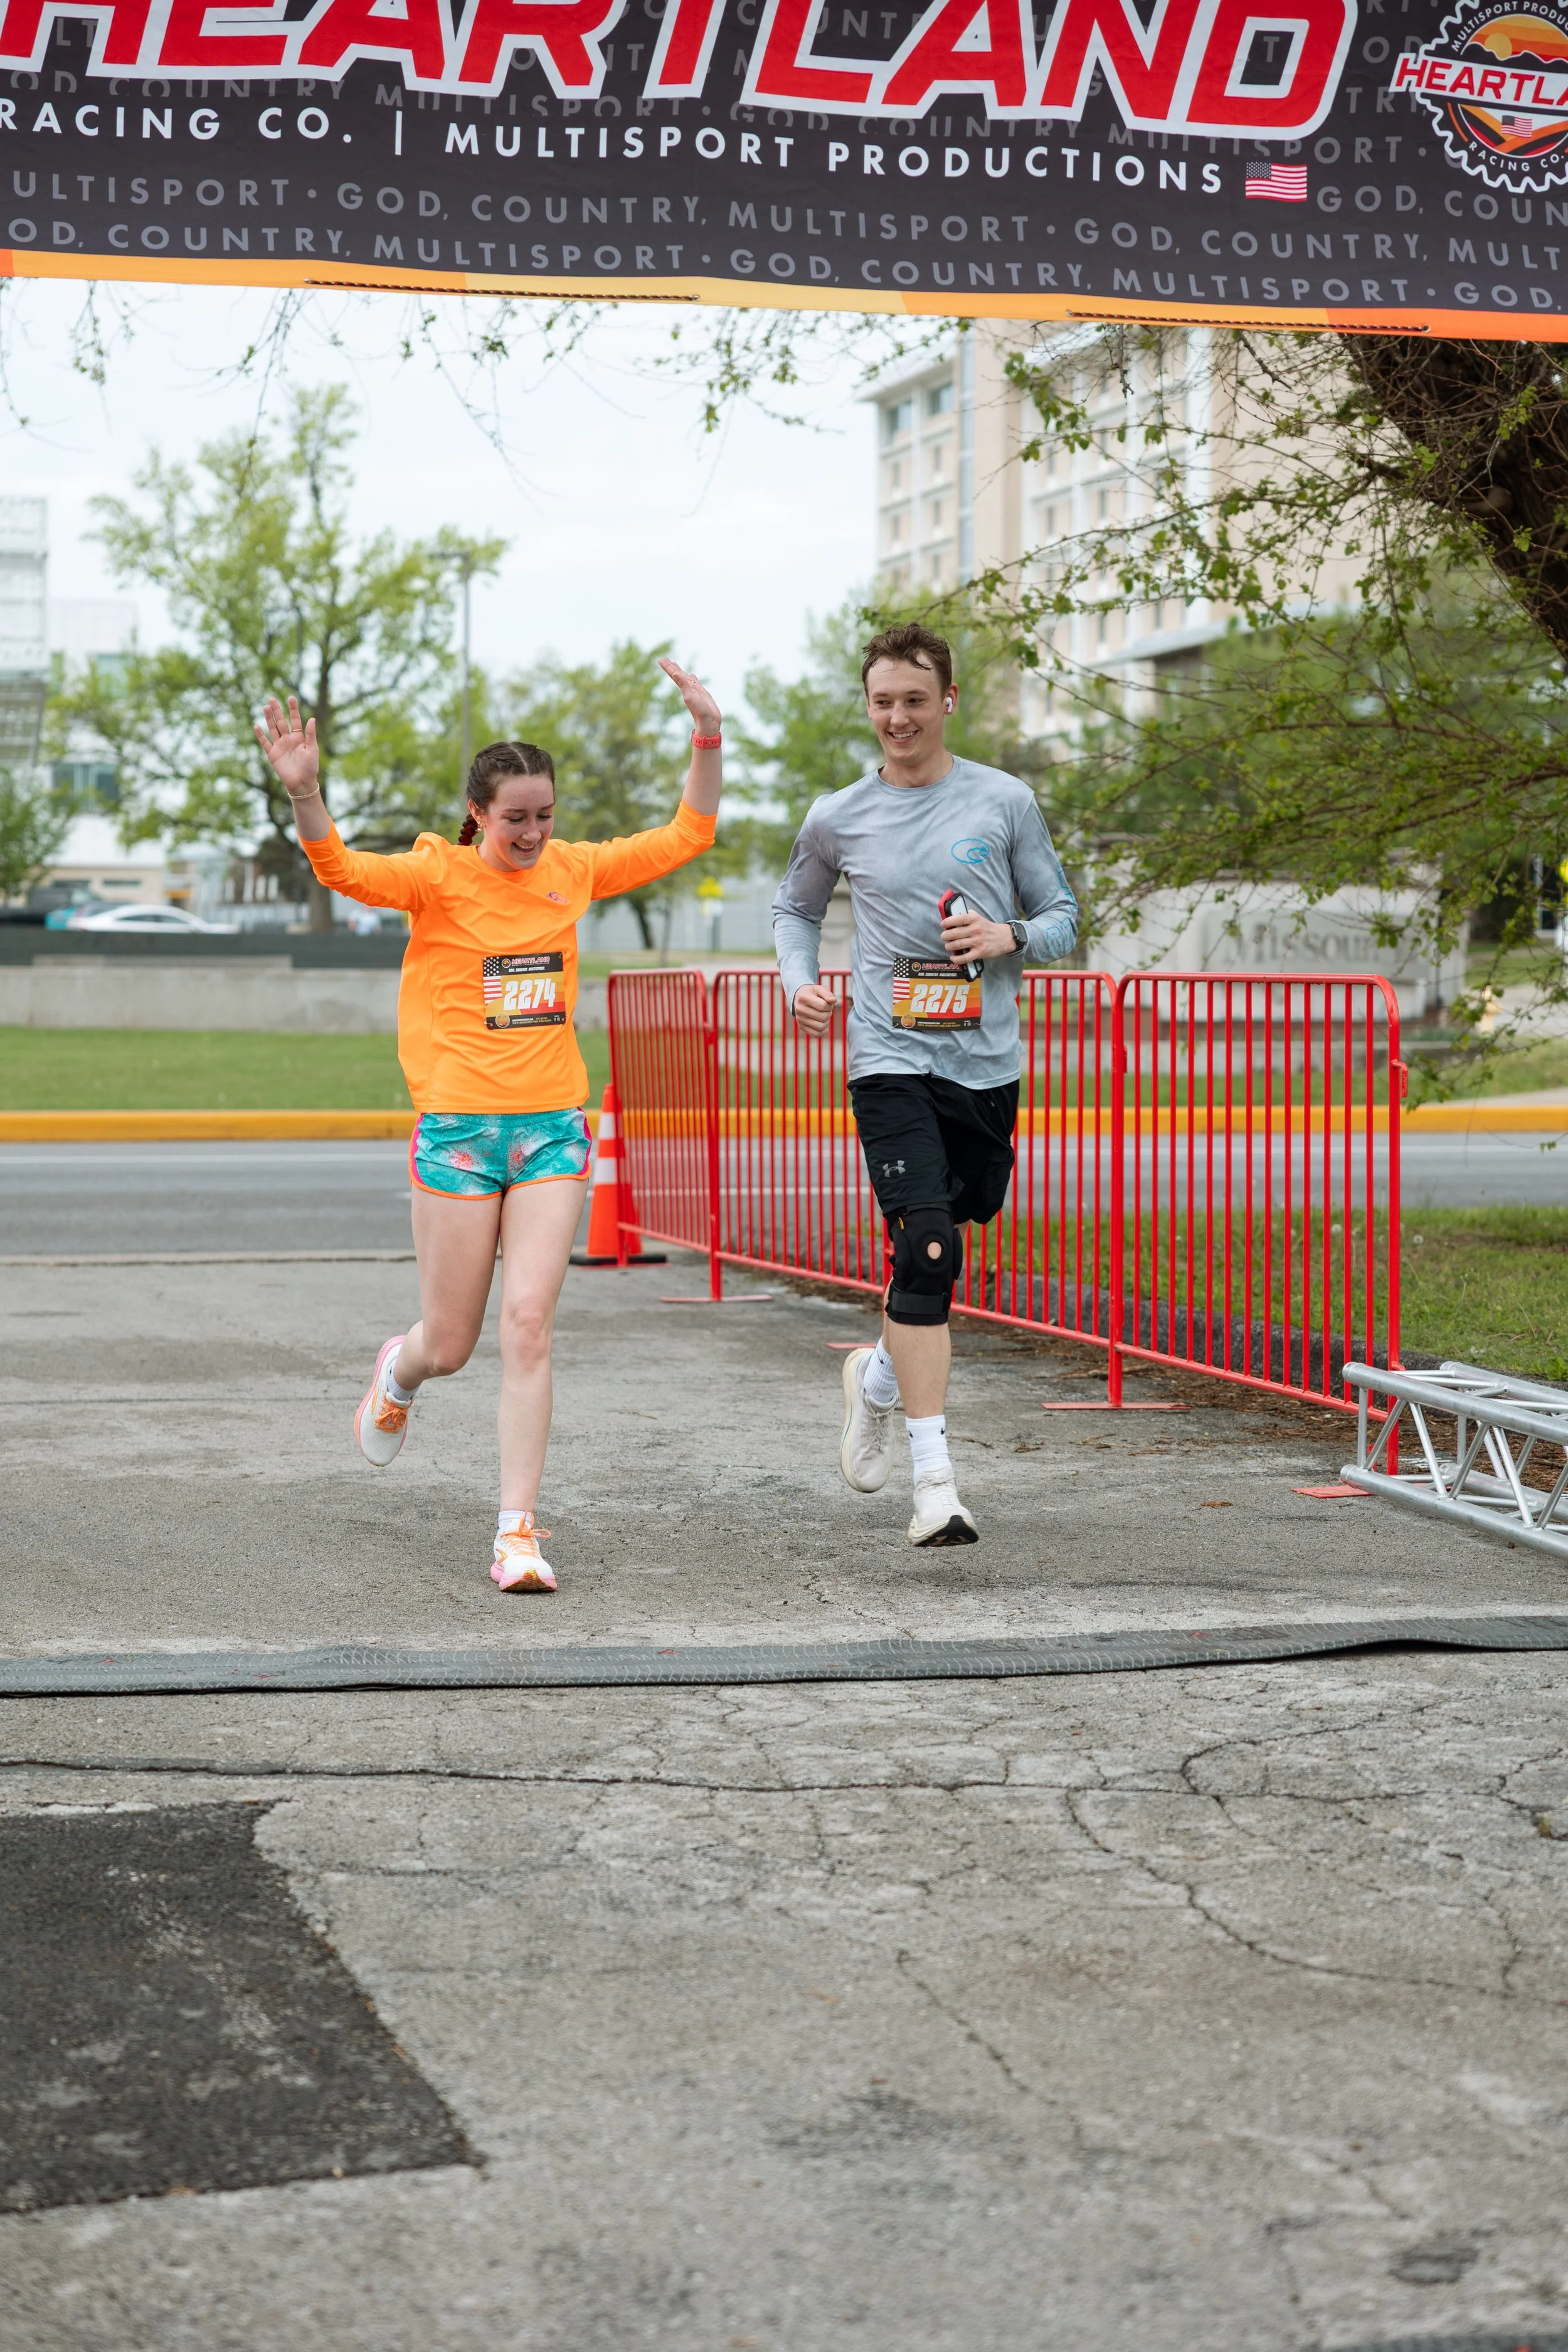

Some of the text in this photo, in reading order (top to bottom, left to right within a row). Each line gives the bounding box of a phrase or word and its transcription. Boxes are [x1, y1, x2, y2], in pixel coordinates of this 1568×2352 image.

[1451, 1, 1519, 53] MULTISPORT
[0, 98, 220, 140] RACING
[258, 107, 352, 143] CO.
[445, 123, 793, 167] MULTISPORT
[829, 142, 1221, 193] PRODUCTIONS
[1468, 141, 1530, 172] RACING
[1540, 153, 1565, 168] CO.
[13, 171, 1561, 271] ULTISPORT GOD, COUNTRY, MULTISPORT GOD, COUNTRY, MULT
[1318, 186, 1568, 228] GOD, COUN
[107, 224, 350, 257] COUNTRY,
[373, 235, 685, 272] MULTISPORT
[729, 248, 840, 282] GOD,
[862, 260, 1091, 291] COUNTRY,
[1113, 268, 1409, 304] MULTISPORT
[1453, 281, 1562, 311] GOD,
[511, 956, 550, 965] HEARTLAND
[504, 978, 556, 1010] 2274
[911, 984, 970, 1013] 2275
